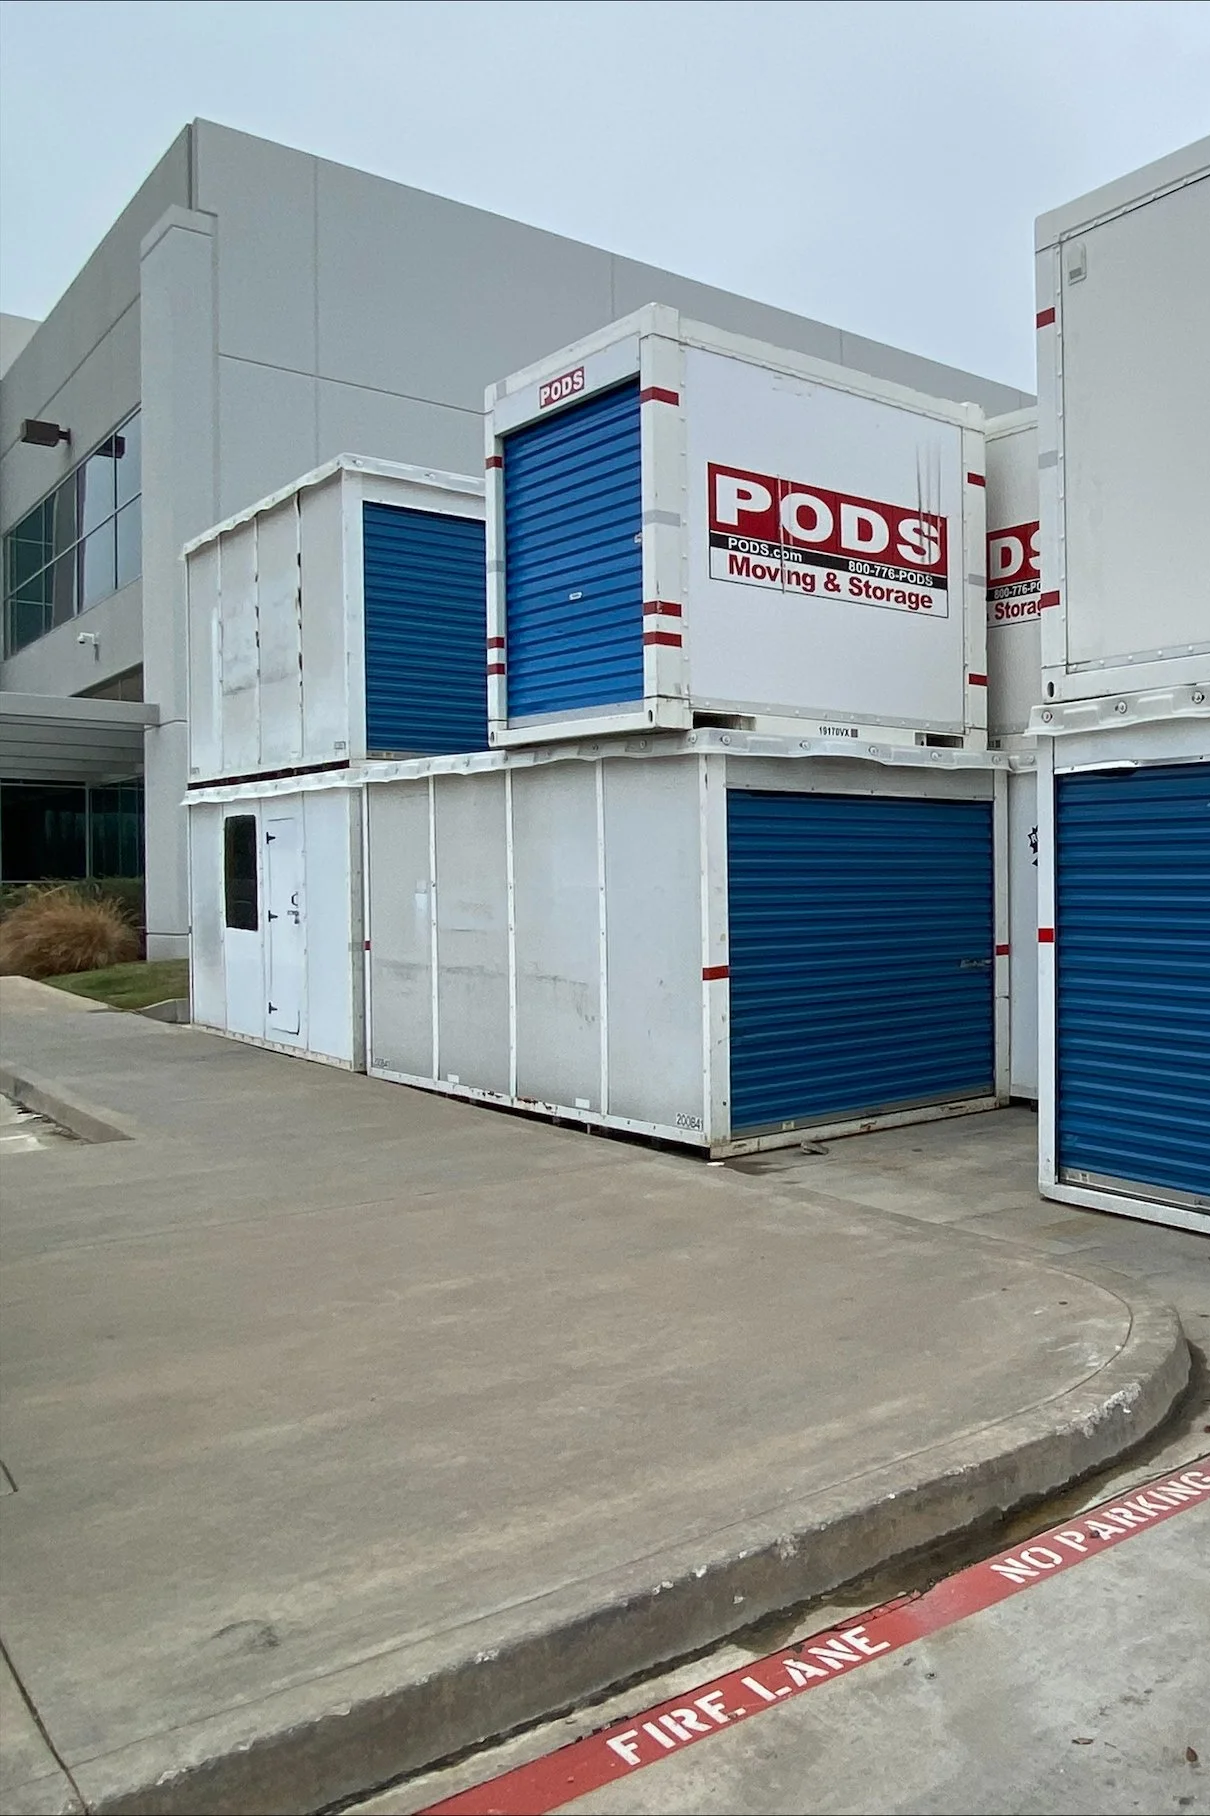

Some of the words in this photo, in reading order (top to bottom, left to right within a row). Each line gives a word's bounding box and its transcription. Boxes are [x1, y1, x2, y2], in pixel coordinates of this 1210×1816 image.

[541, 370, 583, 406] PODS
[715, 473, 942, 566] PODS
[728, 537, 802, 562] PODS.com
[848, 560, 934, 586] 800-776-PODS
[728, 554, 816, 593] Moving
[823, 572, 841, 593] &
[849, 577, 933, 611] Storage
[994, 600, 1041, 620] Stora
[991, 1547, 1063, 1584] NO
[605, 1690, 746, 1766] FIRE
[741, 1626, 891, 1701] LANE
